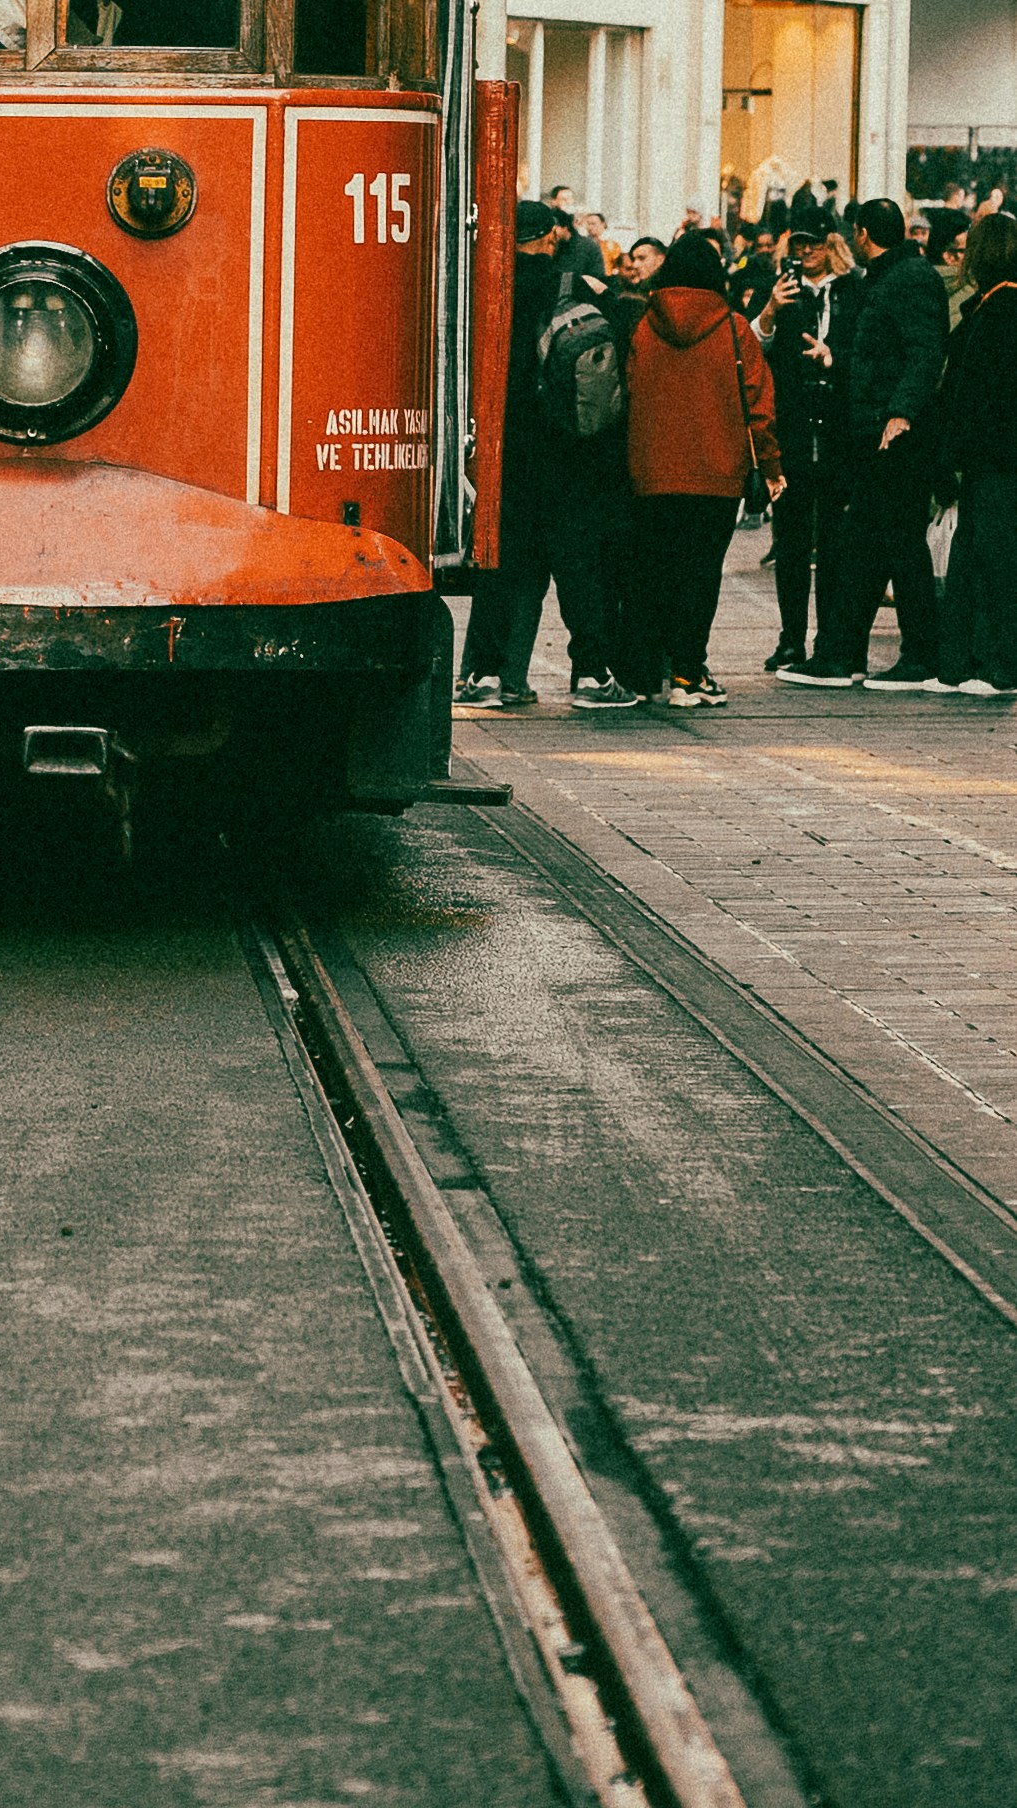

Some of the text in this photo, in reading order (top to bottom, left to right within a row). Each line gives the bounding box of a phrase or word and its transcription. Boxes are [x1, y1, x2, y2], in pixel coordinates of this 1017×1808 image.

[344, 173, 411, 244] 115
[325, 408, 399, 436] ASILMAK
[315, 443, 342, 471] VE
